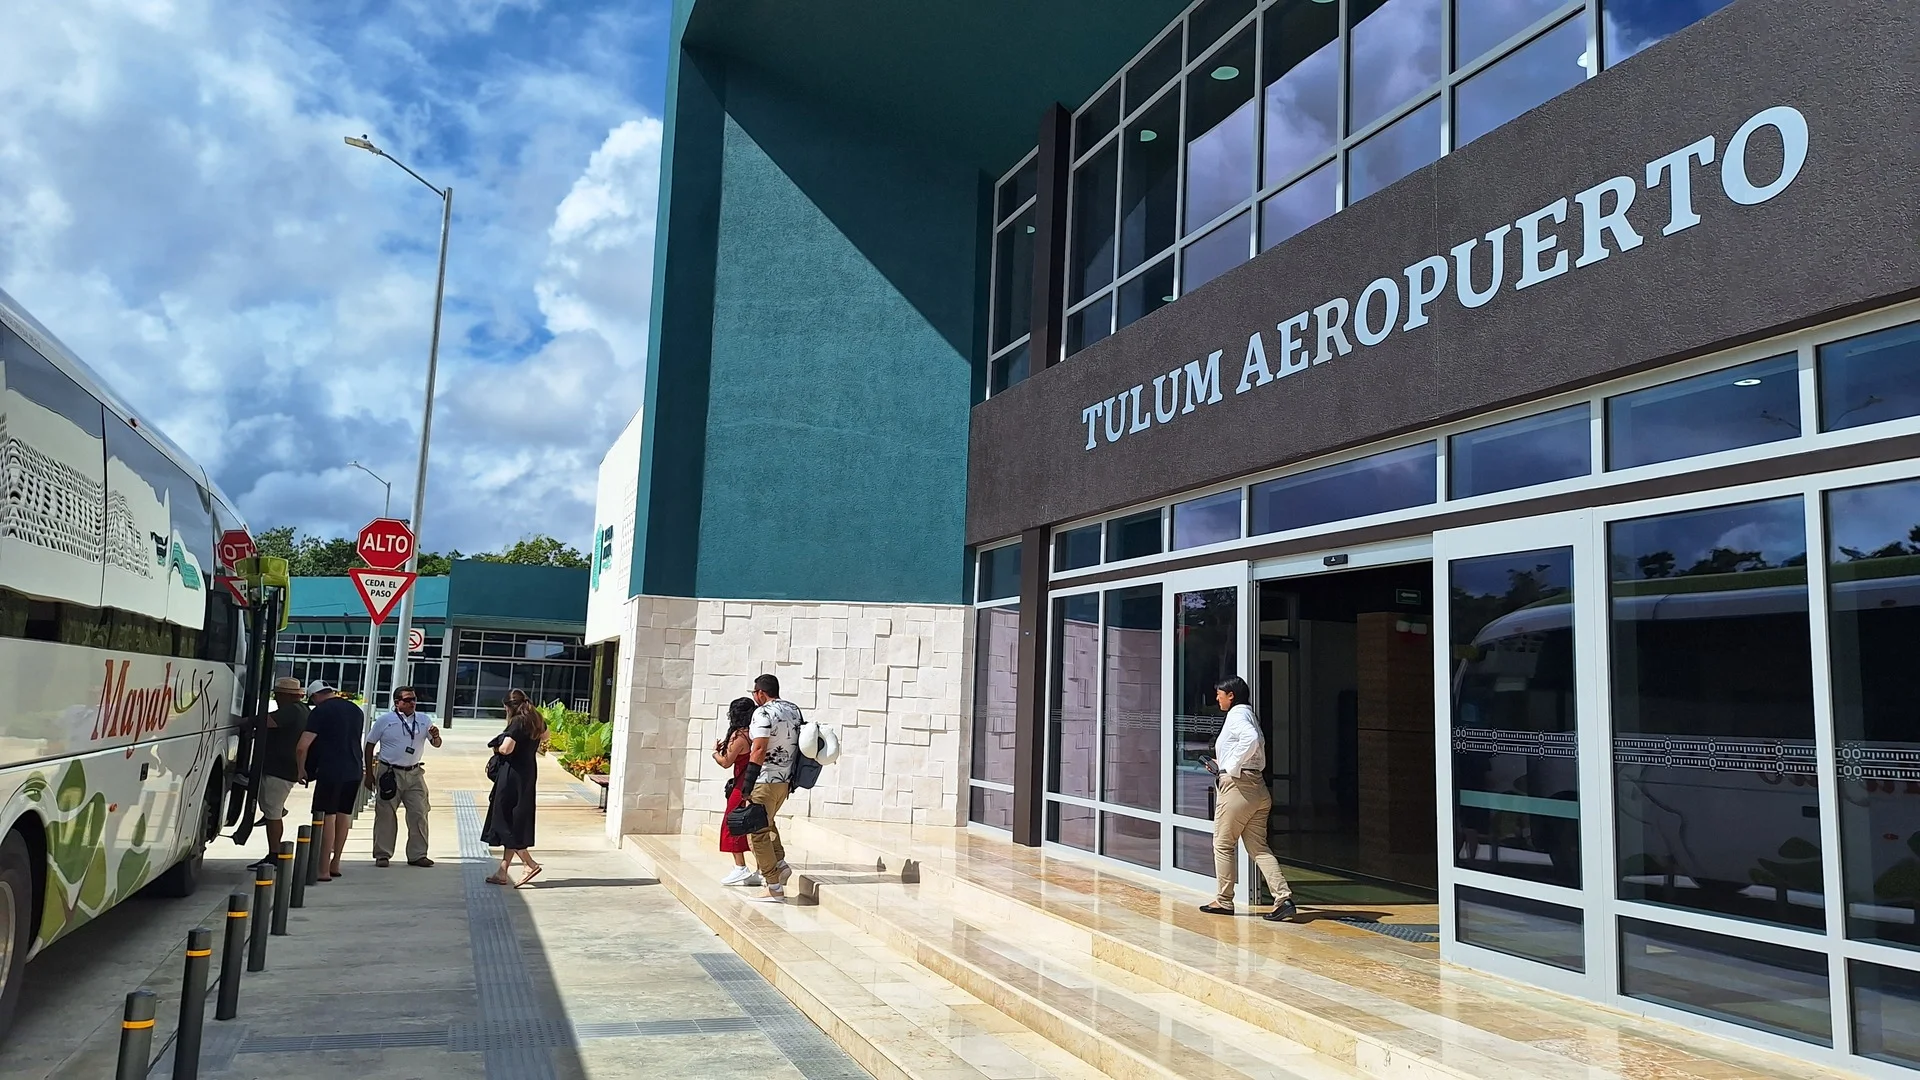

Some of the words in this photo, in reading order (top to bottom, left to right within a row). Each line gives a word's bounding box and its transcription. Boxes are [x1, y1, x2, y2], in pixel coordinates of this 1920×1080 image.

[1081, 349, 1223, 451] TULUM
[1235, 105, 1810, 394] AEROPUERTO
[362, 532, 409, 553] ALTO
[365, 578, 385, 587] CEDA
[388, 580, 397, 589] EL
[370, 589, 392, 598] PASO
[91, 659, 172, 759] Mayab
